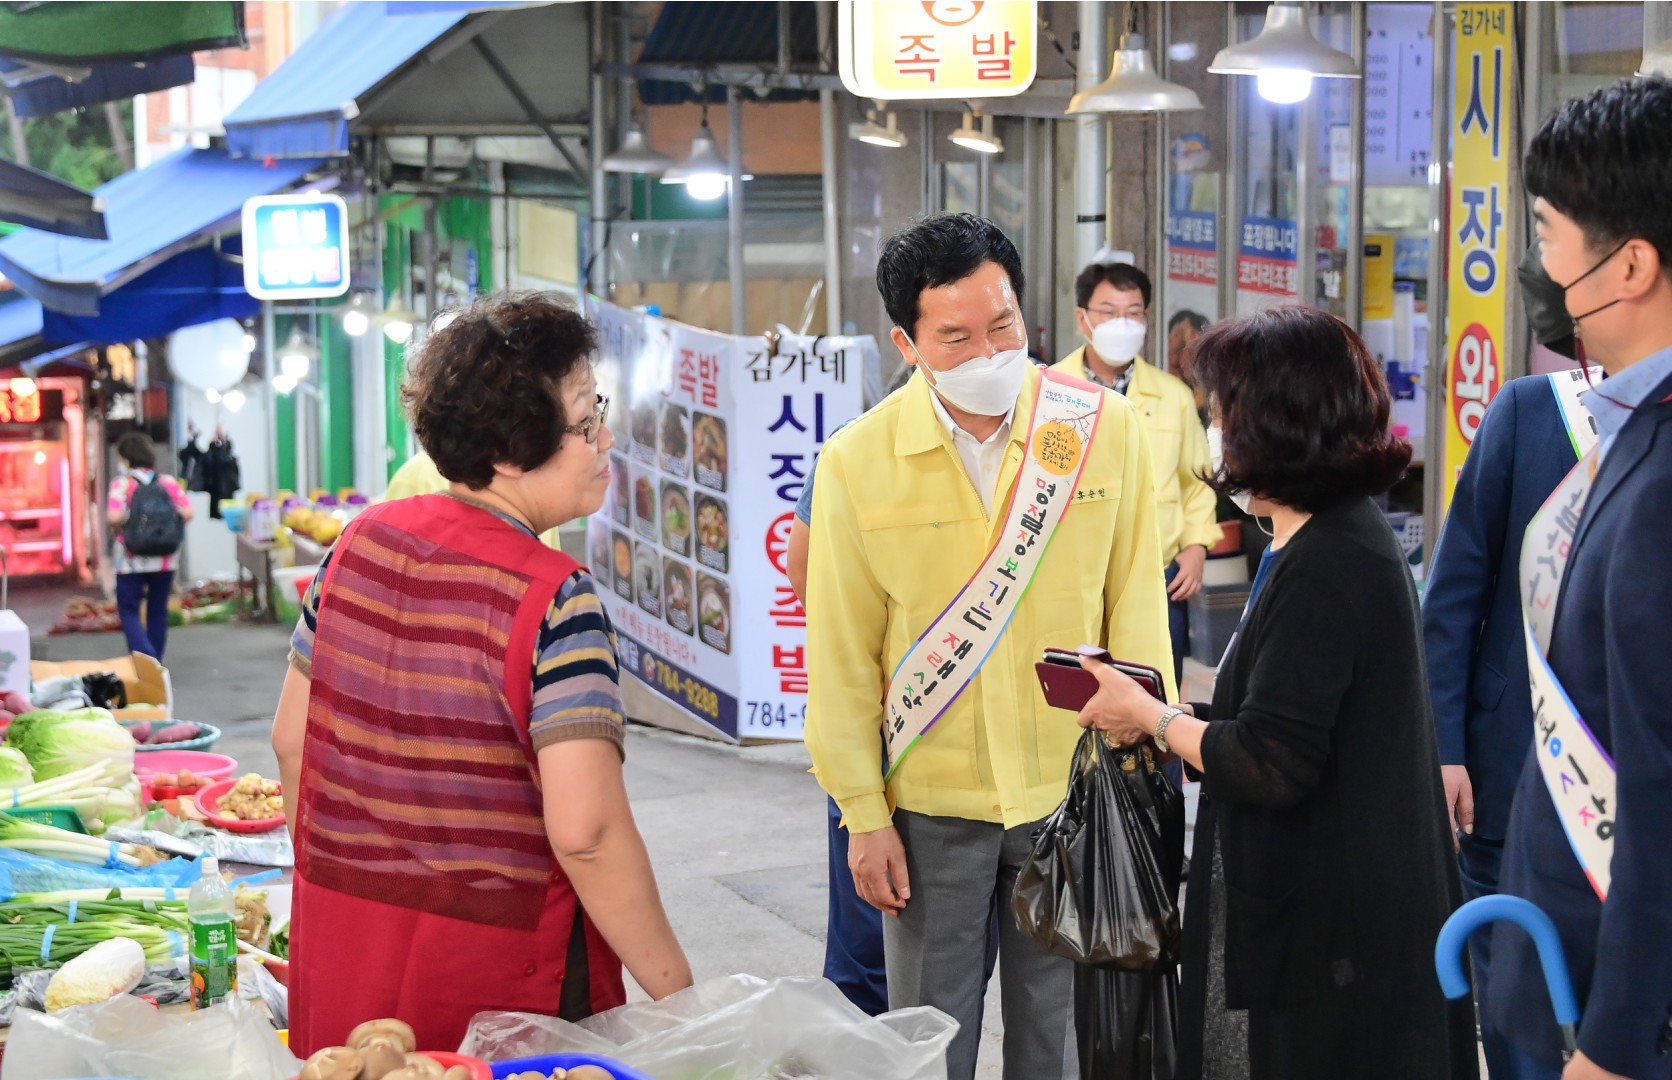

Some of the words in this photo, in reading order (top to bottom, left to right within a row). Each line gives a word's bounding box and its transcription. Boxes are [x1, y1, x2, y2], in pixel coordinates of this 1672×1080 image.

[1460, 7, 1505, 36] 김가네
[894, 31, 1016, 82] 족발
[1243, 223, 1297, 254] 포장됩니다
[1455, 47, 1503, 478] 시장왕
[679, 347, 719, 409] 족발
[745, 349, 845, 384] 김가네
[747, 701, 807, 728] 784-
